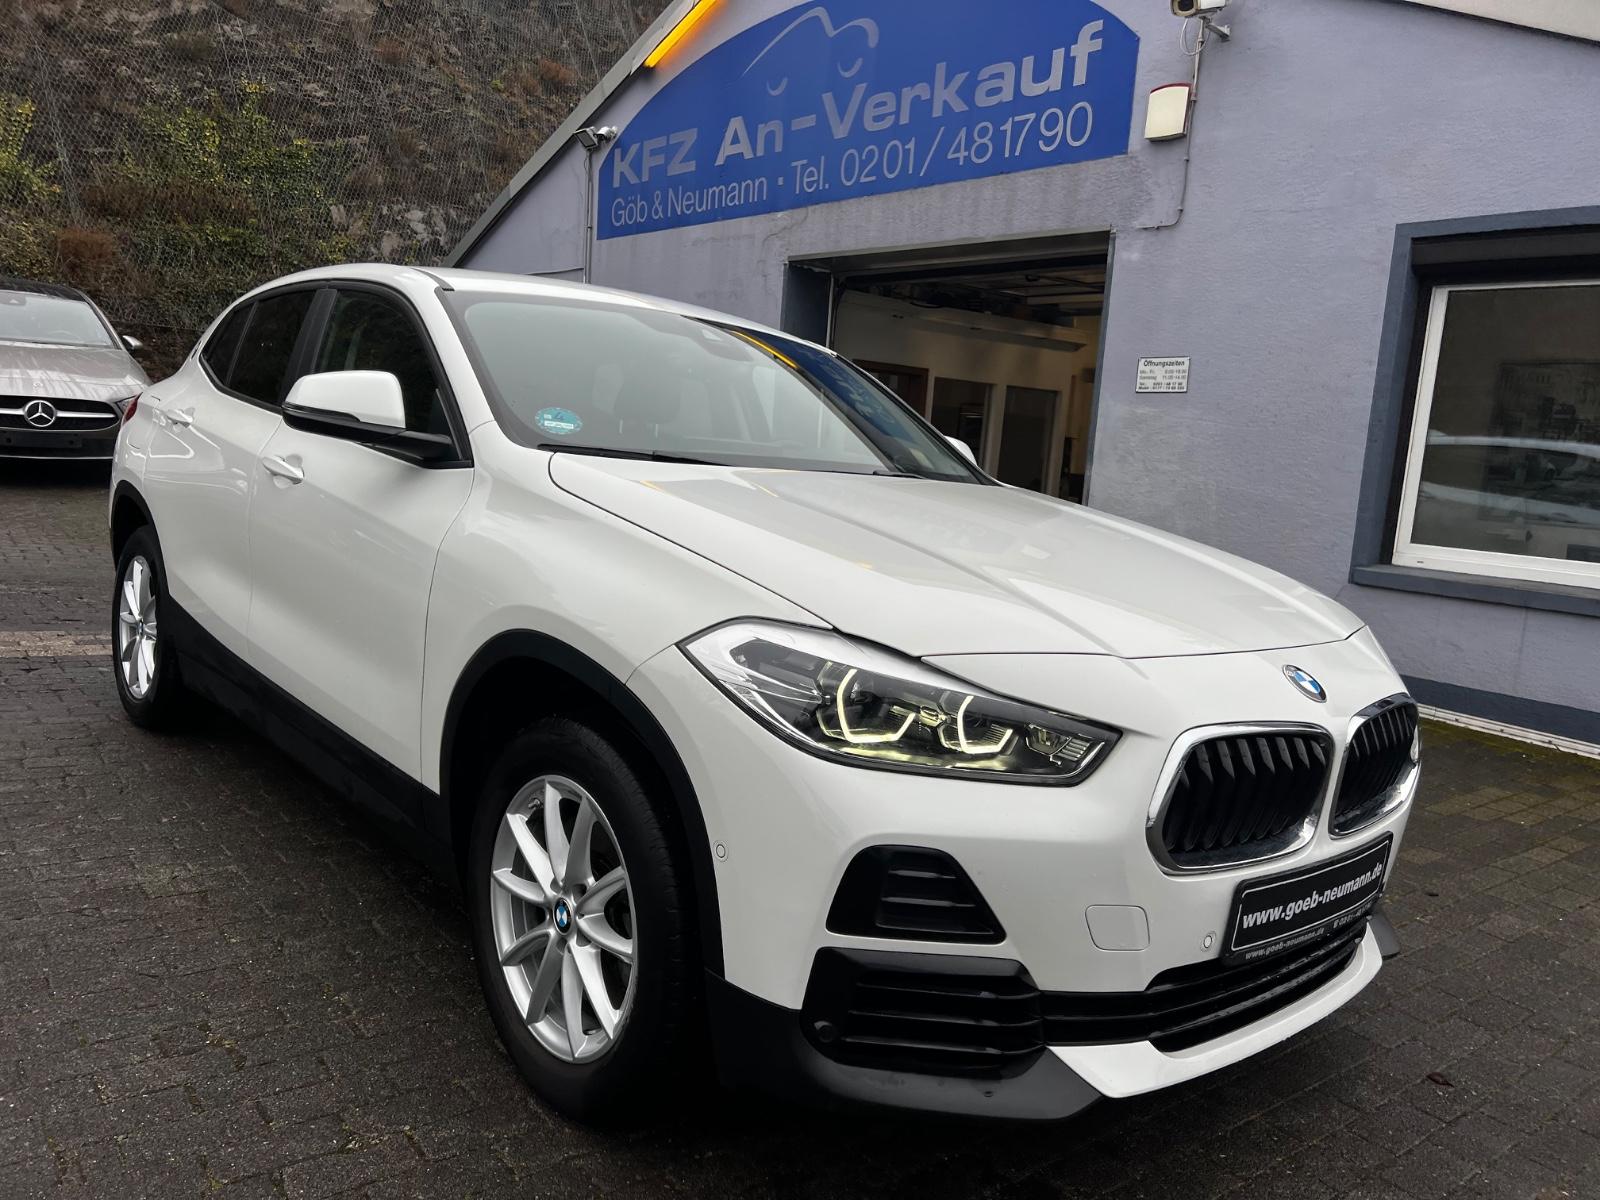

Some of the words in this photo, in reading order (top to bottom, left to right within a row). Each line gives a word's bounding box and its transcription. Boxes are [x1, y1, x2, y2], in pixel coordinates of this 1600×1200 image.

[611, 128, 698, 188] KFZ
[714, 19, 1104, 166] An-Verkauf
[611, 195, 648, 228] Göb
[652, 191, 663, 219] &
[667, 174, 768, 218] Neumann
[791, 158, 830, 195] Tel.
[1242, 862, 1383, 929] www.goeb-neumann.de
